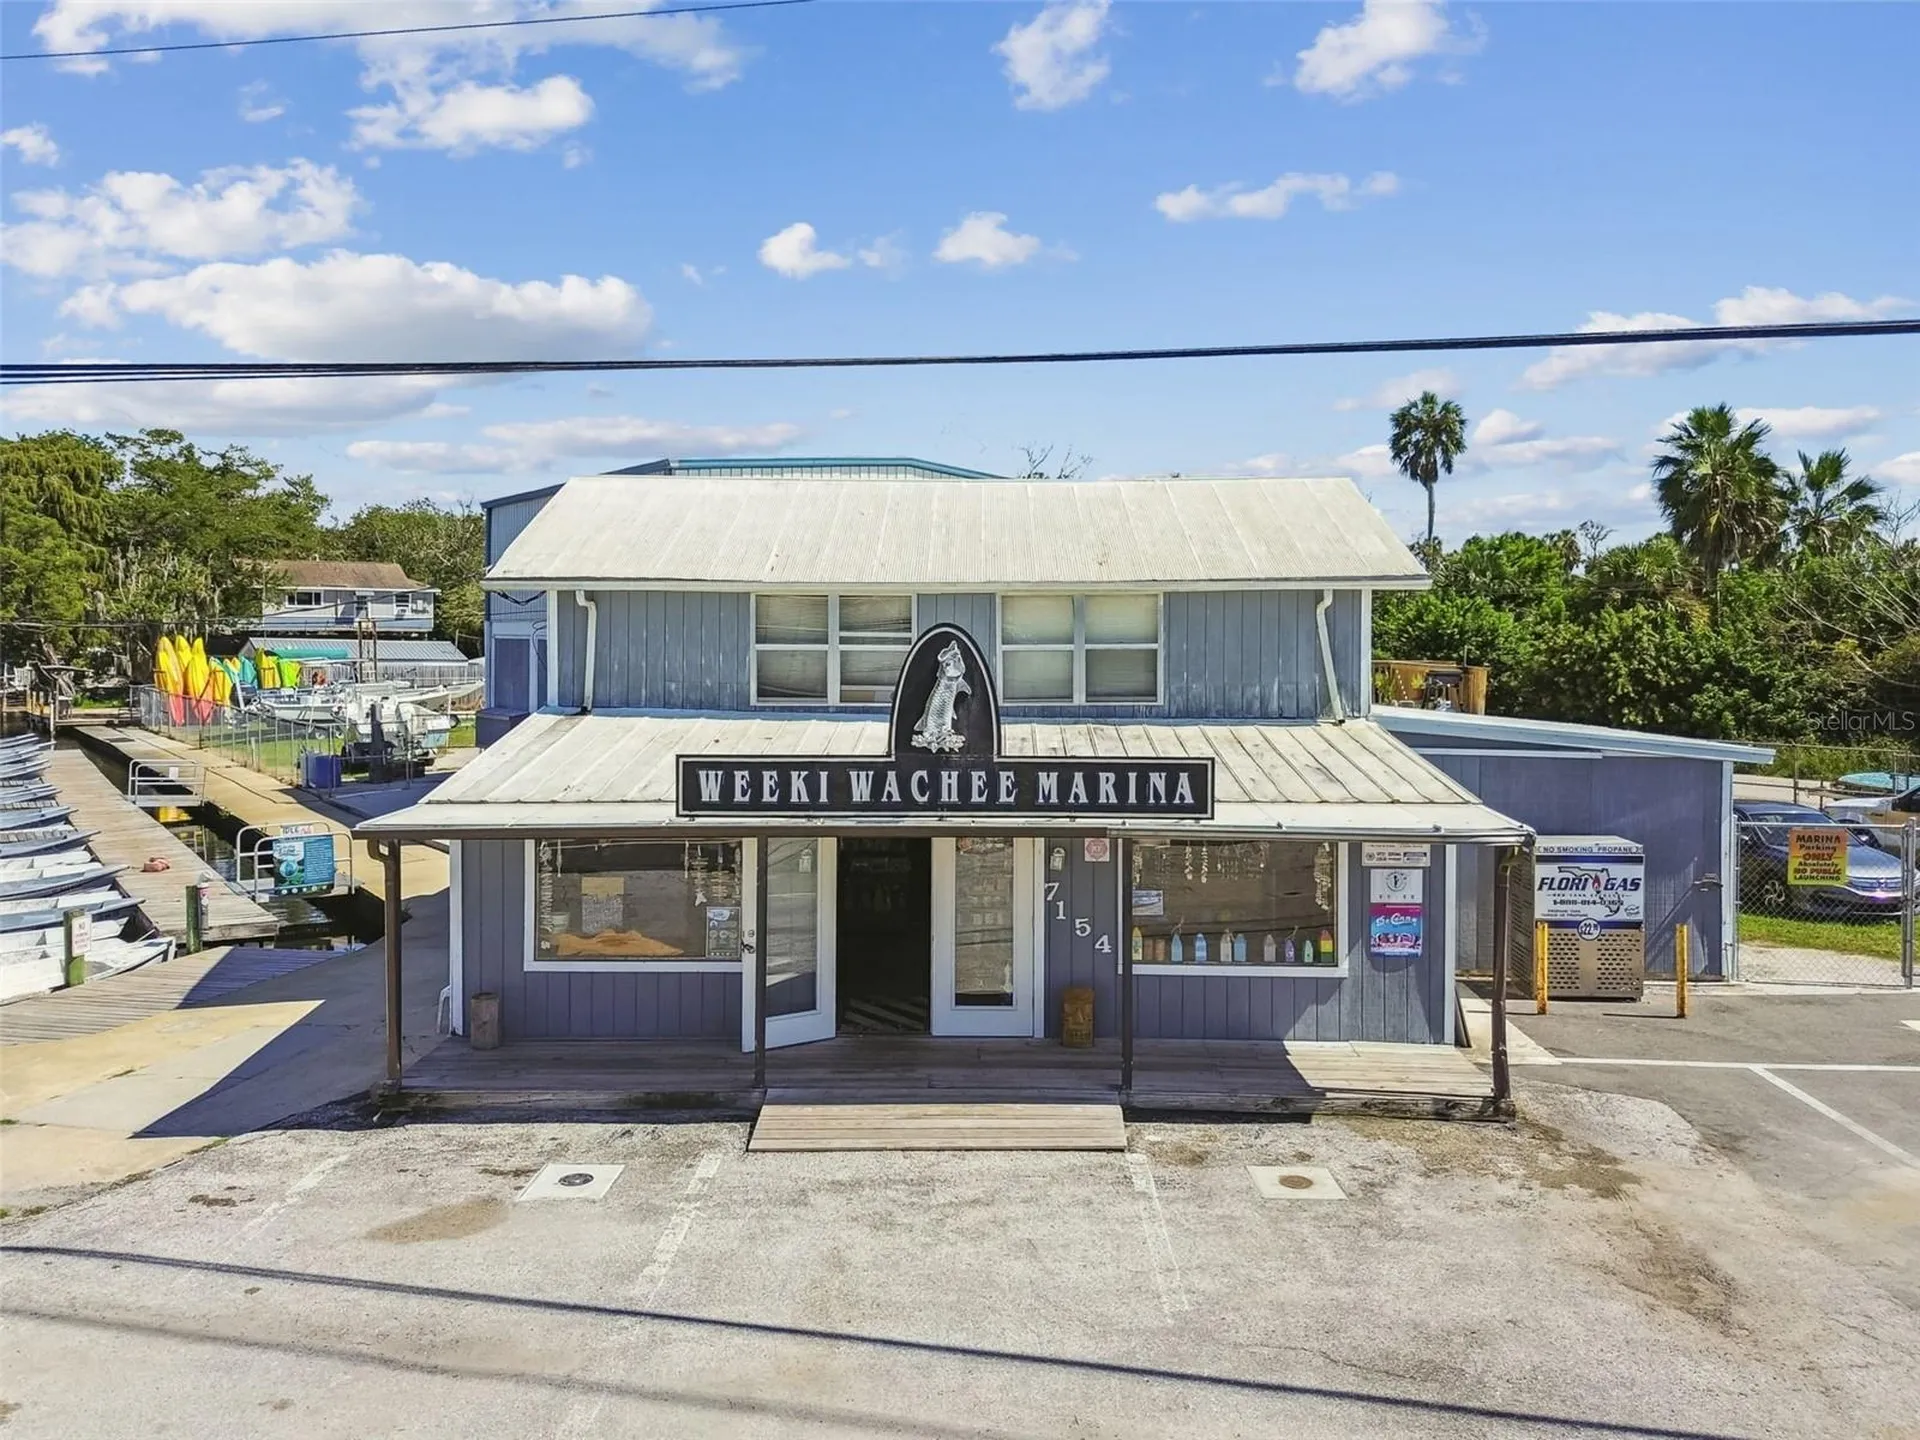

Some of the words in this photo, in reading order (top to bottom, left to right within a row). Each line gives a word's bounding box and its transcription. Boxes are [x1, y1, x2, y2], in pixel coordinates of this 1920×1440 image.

[698, 769, 829, 803] WEEKI
[849, 769, 1018, 803] WACHEE
[1037, 771, 1195, 804] MARINA
[1796, 834, 1841, 844] MARINA
[1597, 846, 1633, 854] PROPANE
[1800, 843, 1837, 852] Parking
[1803, 852, 1834, 861] ONLY
[1537, 877, 1590, 891] FLORI
[1603, 877, 1642, 891] GAS
[1044, 882, 1112, 953] 7154
